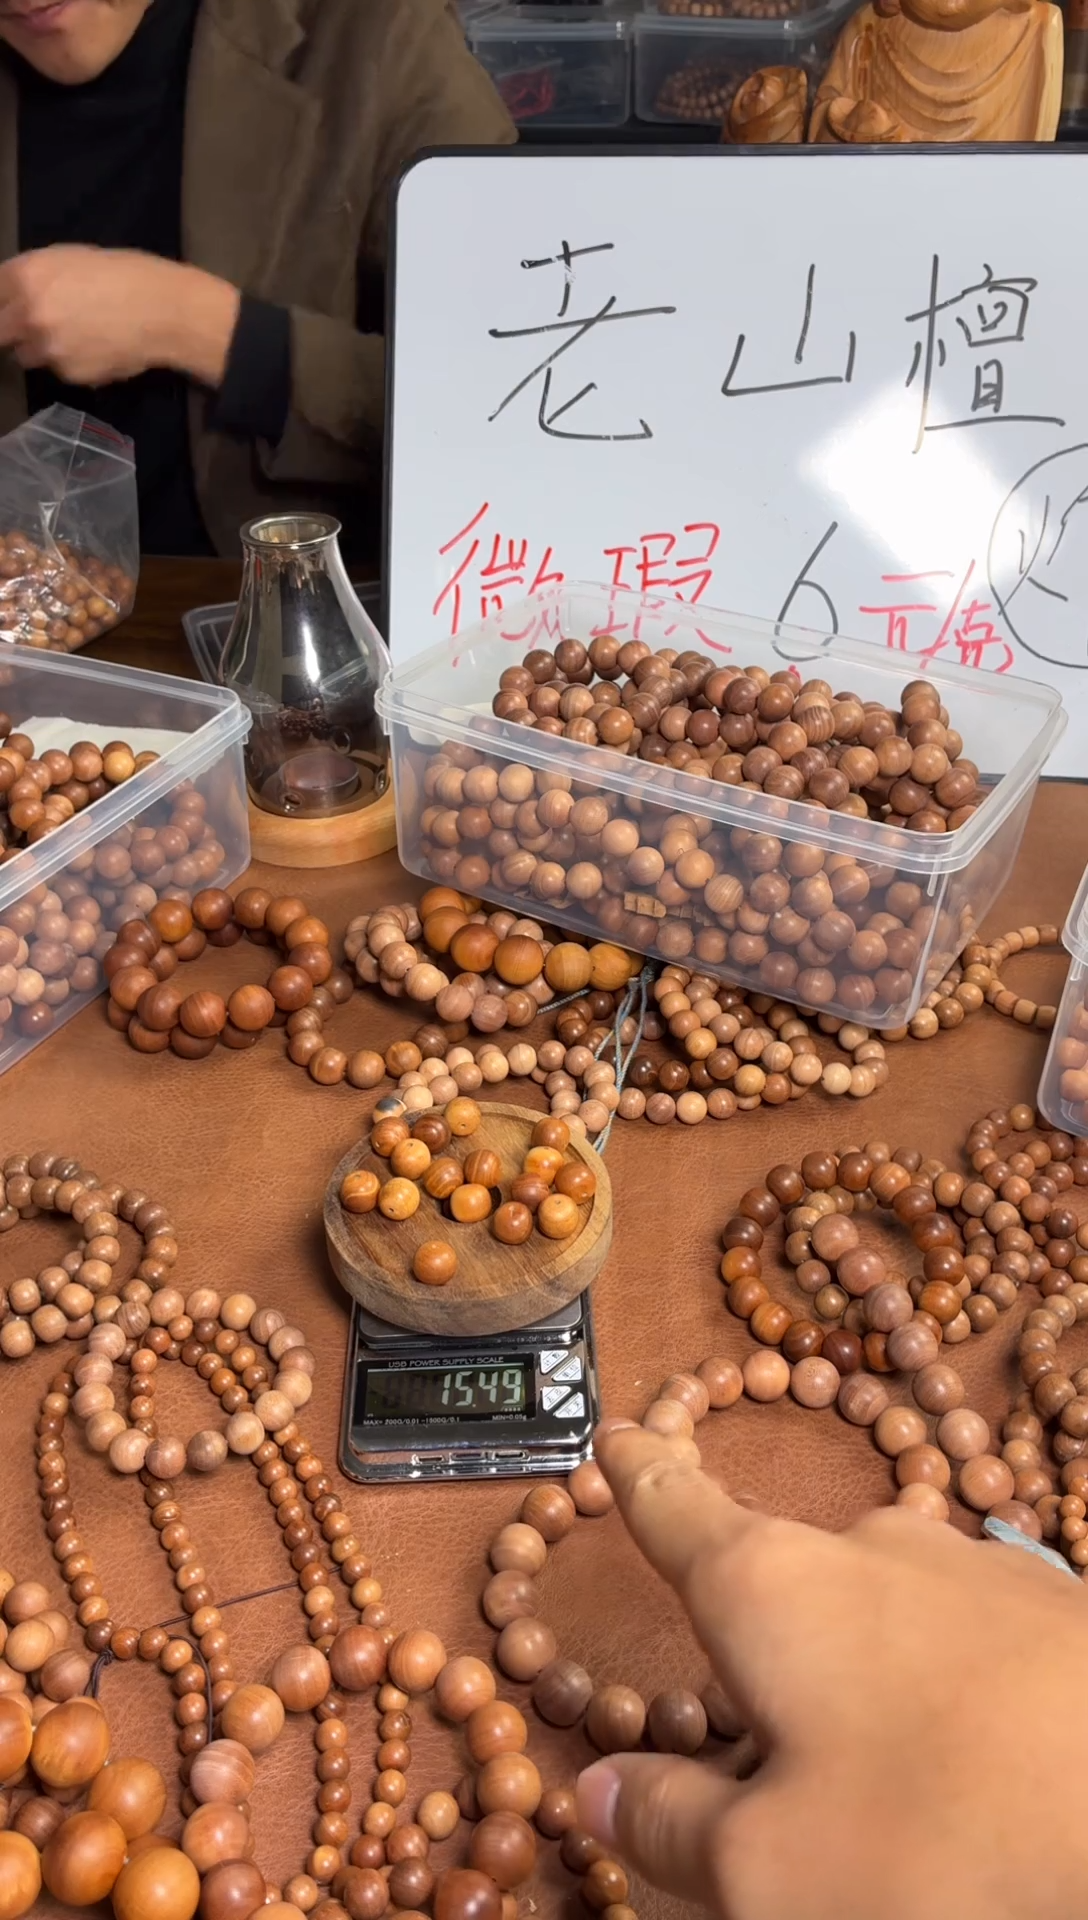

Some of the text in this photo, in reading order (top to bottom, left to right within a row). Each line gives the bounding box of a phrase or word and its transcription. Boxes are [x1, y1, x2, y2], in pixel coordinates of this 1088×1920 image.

[409, 1359, 440, 1367] POWER
[442, 1358, 475, 1366] SUPPLY
[476, 1356, 504, 1364] SCALE
[441, 1369, 523, 1407] 15.49
